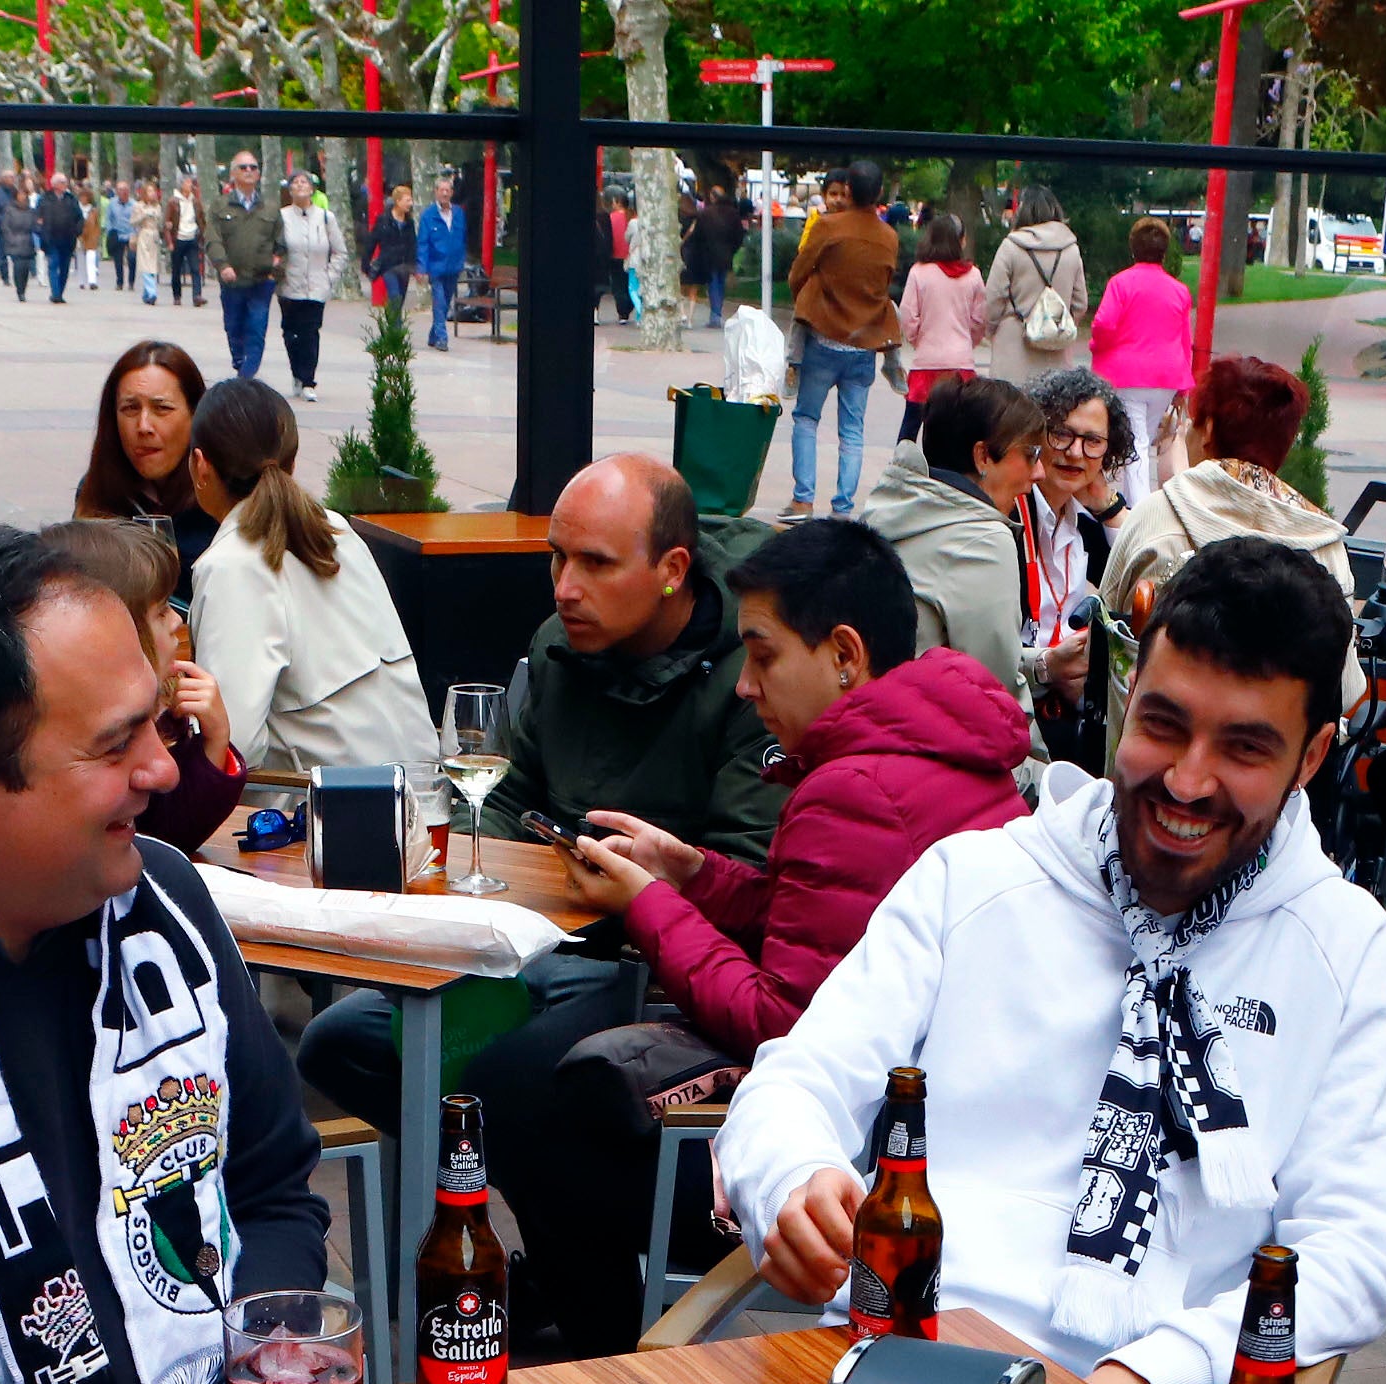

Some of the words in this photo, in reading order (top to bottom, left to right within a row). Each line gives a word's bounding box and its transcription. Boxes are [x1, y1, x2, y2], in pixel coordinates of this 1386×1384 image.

[1235, 995, 1258, 1011] THE
[1213, 1004, 1258, 1021] NORTH
[1223, 1014, 1255, 1031] FACE
[160, 1137, 207, 1172] CLUB
[450, 1152, 479, 1162] Estrella
[450, 1160, 479, 1170] Galicia
[133, 1216, 181, 1303] BURGOS
[430, 1316, 502, 1339] Estrella
[1258, 1316, 1291, 1326] Estrella
[1258, 1325, 1290, 1336] Galicia
[432, 1338, 500, 1360] Galicia
[447, 1366, 488, 1383] Especial
